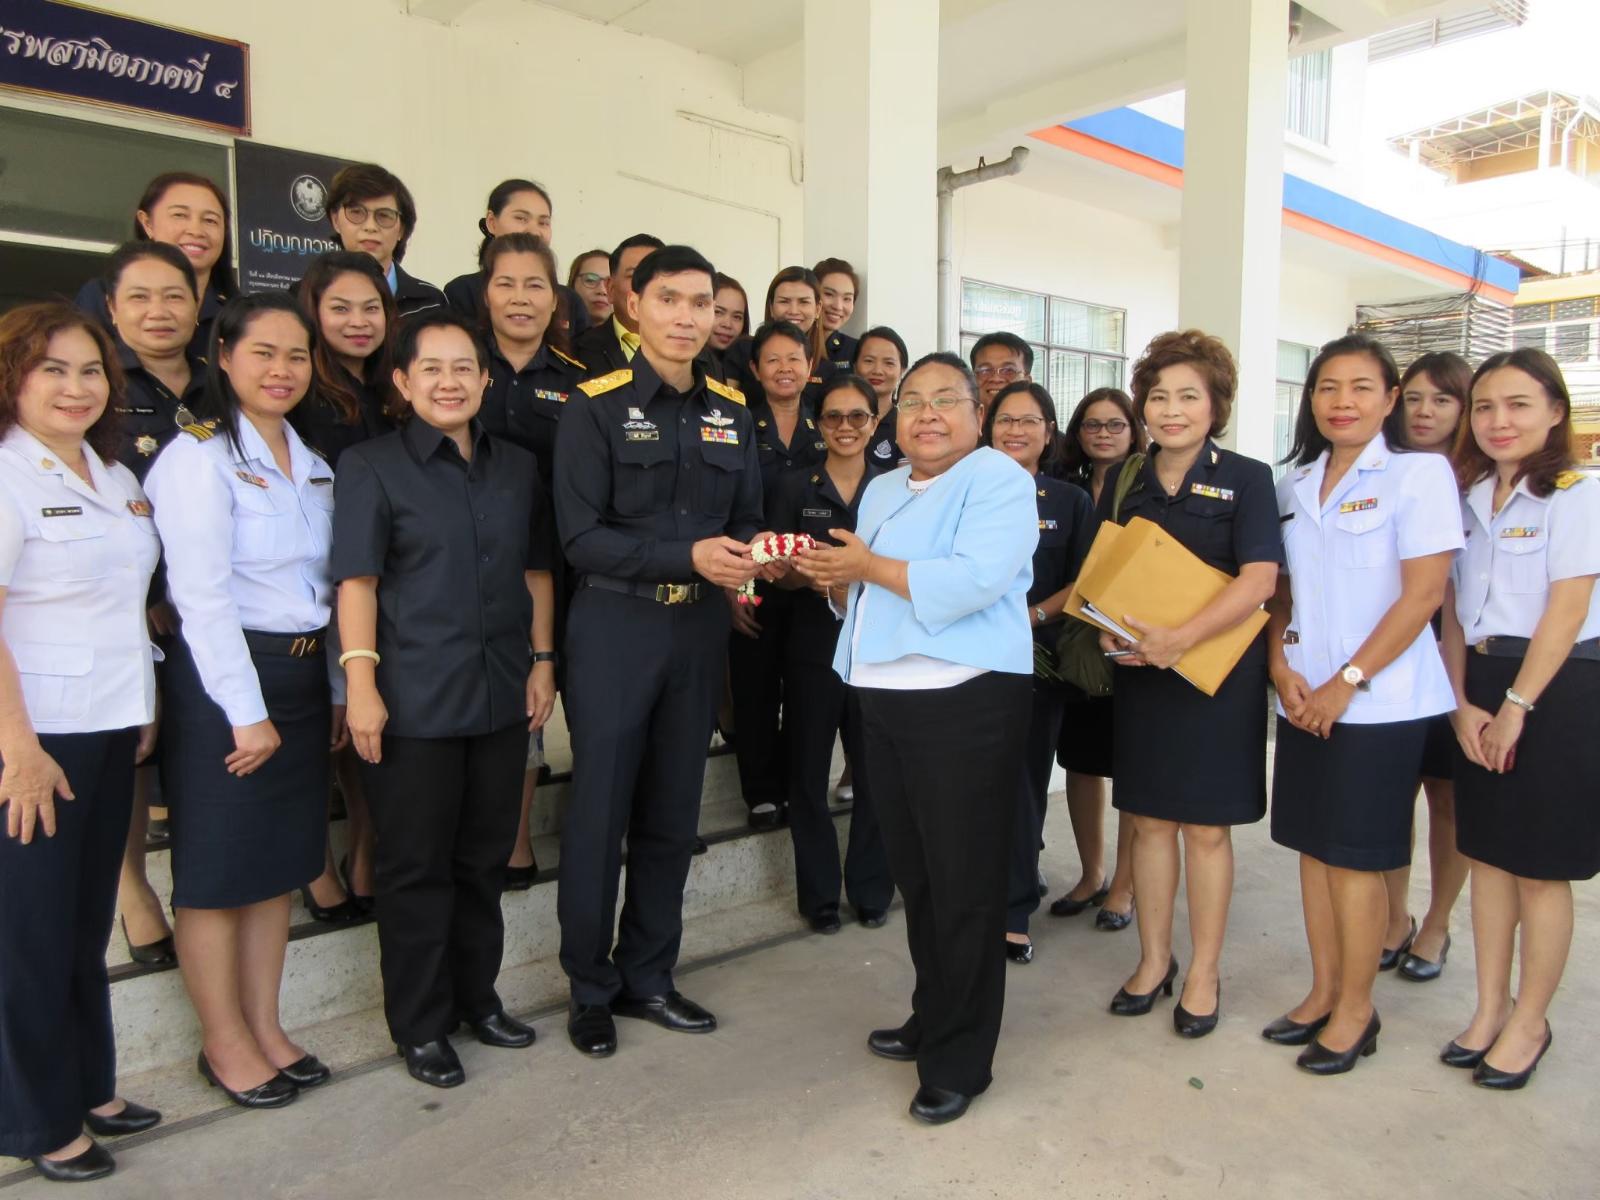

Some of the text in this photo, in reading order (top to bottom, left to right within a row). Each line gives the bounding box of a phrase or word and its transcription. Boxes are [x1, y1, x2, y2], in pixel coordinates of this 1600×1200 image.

[0, 26, 238, 99] รพสามิตภาคที่ ๔
[250, 228, 341, 256] ปฏิญญาวาย
